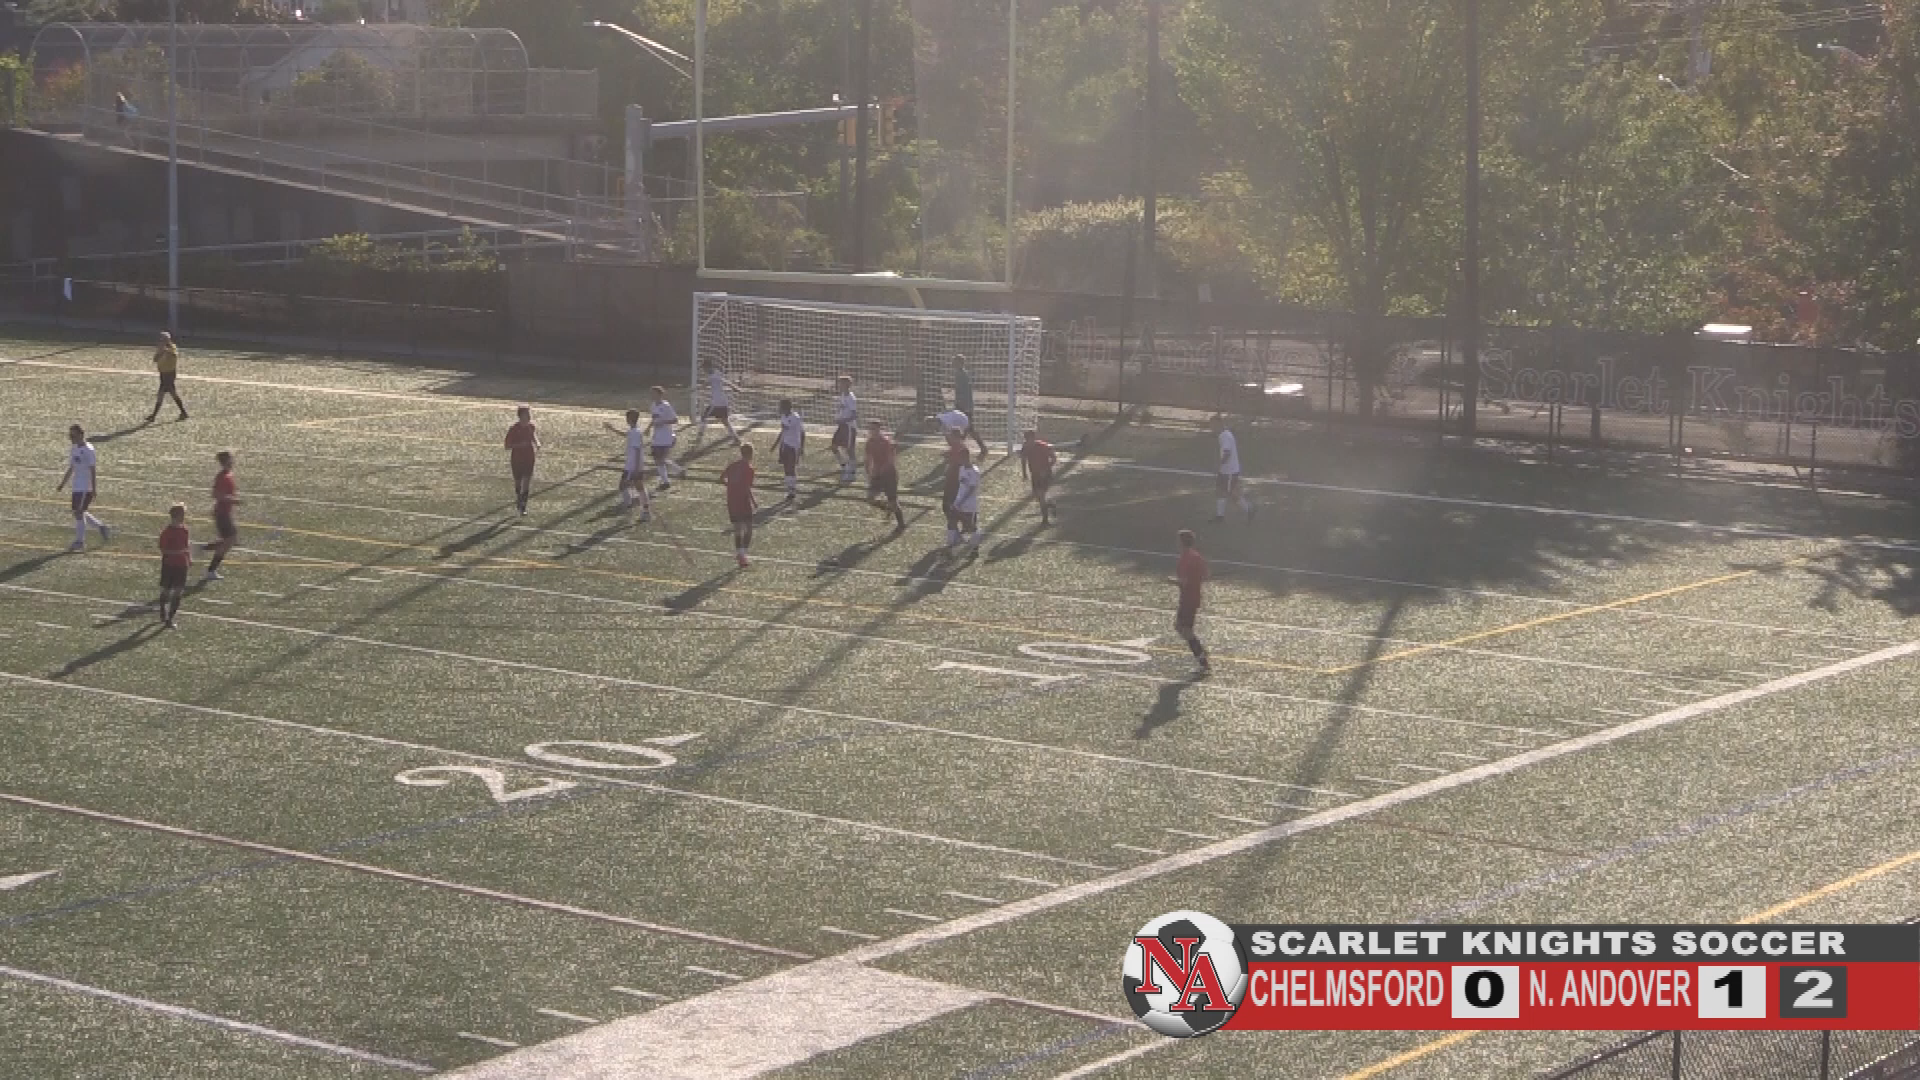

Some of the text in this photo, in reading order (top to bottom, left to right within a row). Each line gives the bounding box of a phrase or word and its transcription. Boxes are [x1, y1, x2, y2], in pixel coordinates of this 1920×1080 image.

[1478, 348, 1920, 438] Scarlet Knights
[394, 740, 678, 803] 20
